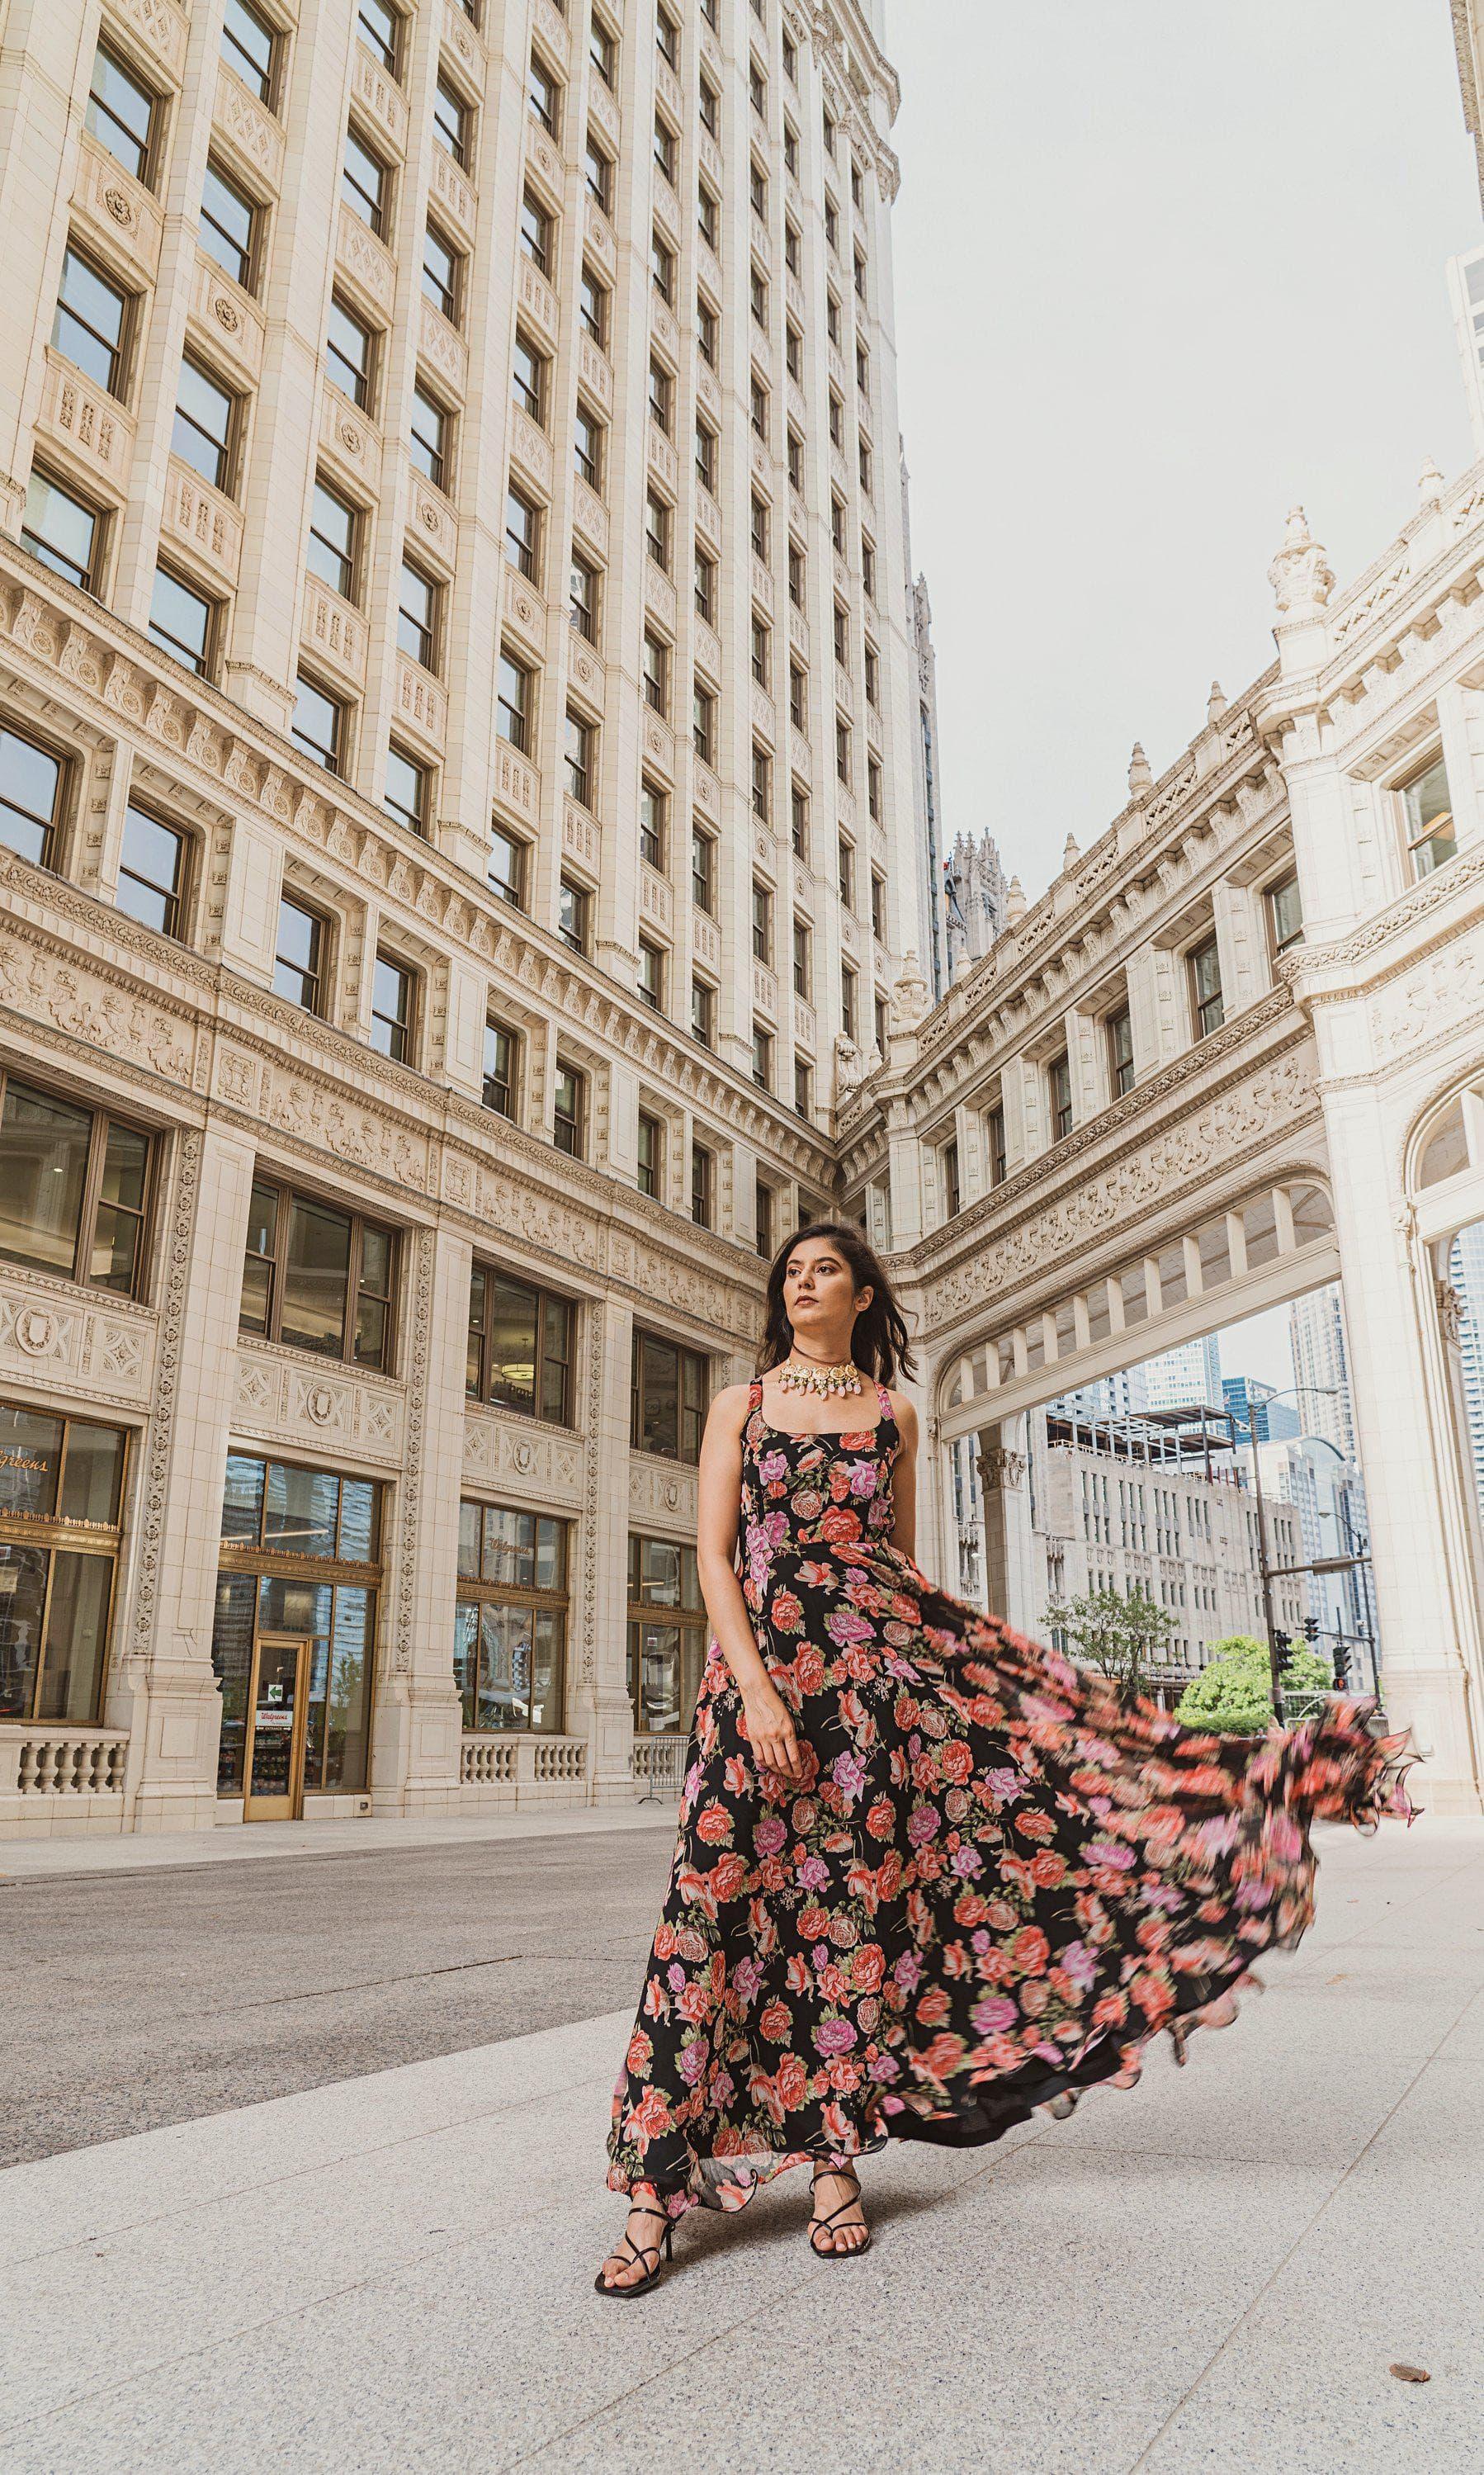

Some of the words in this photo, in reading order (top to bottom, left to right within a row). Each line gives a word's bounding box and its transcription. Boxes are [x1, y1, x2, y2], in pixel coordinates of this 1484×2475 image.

[0, 1449, 49, 1472] greens
[489, 1537, 530, 1555] Walgreens
[261, 1712, 287, 1722] Walgreens
